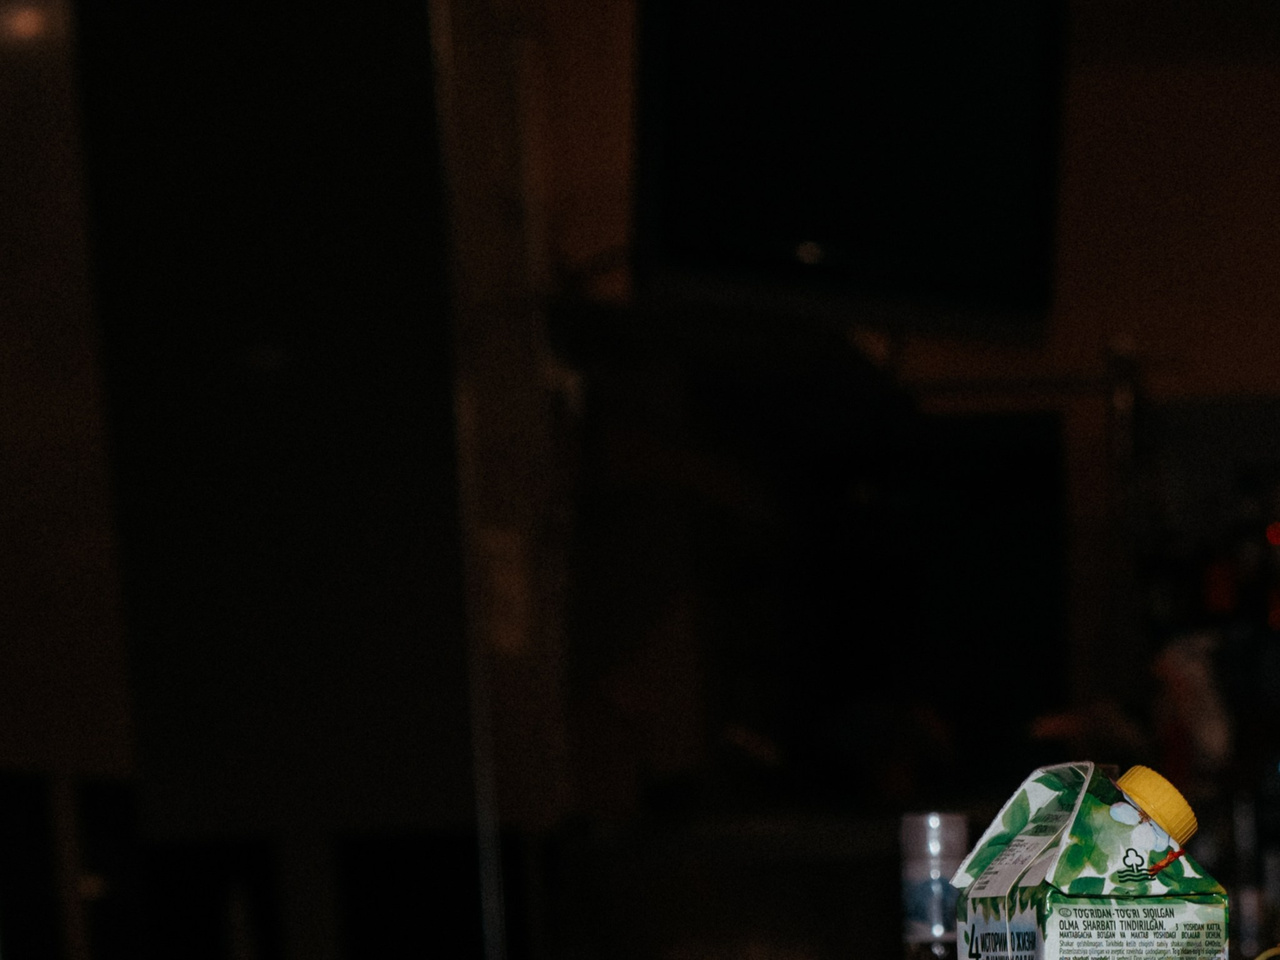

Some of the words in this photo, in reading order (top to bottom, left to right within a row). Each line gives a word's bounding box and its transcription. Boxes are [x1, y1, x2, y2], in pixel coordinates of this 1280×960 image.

[1143, 908, 1175, 920] SIQILGAN
[1059, 920, 1080, 930] OLMA
[1082, 920, 1116, 930] SHARBATI
